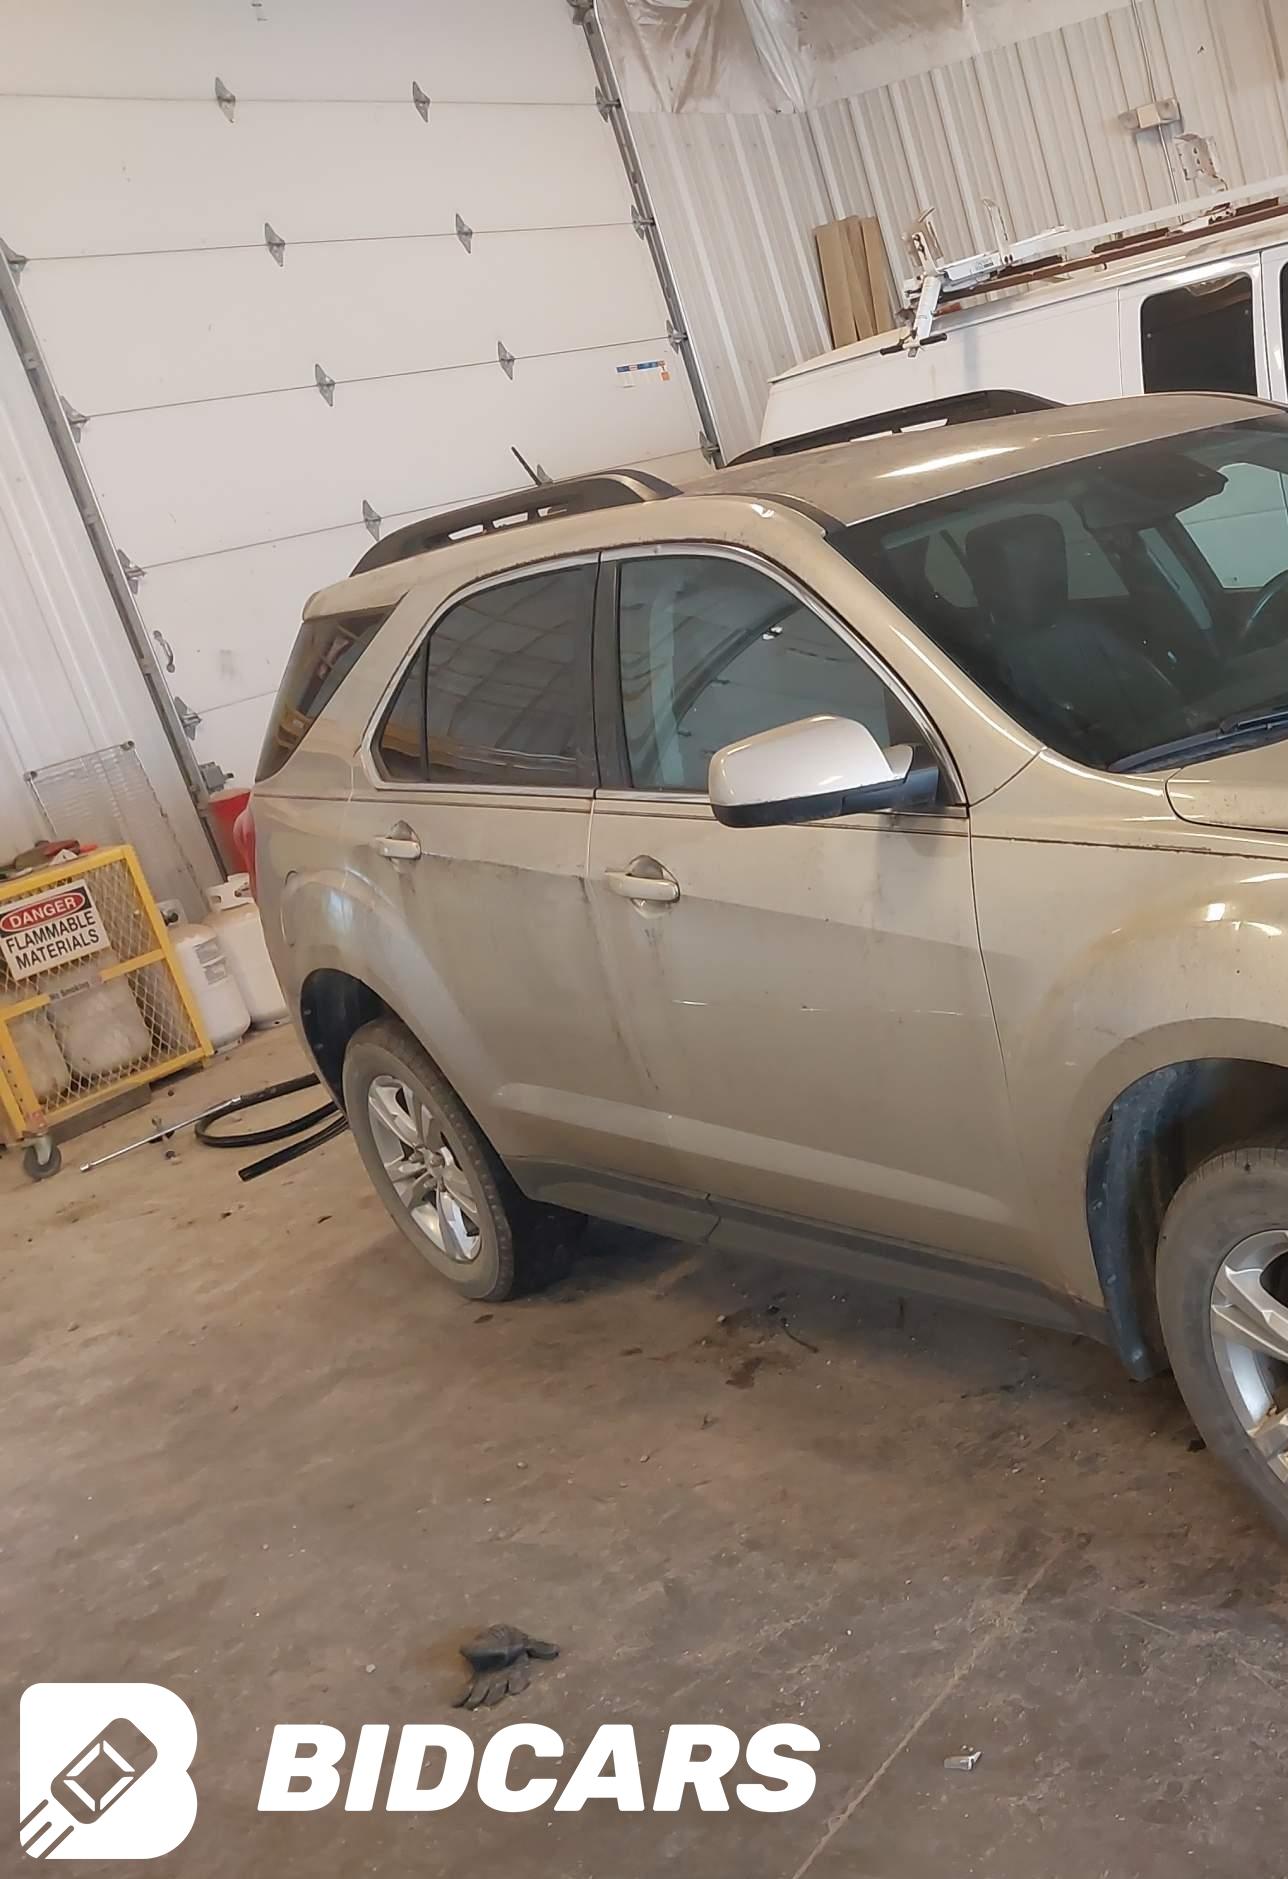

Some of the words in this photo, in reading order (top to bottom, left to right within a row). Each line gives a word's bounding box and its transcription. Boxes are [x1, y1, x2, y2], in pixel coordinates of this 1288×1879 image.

[6, 910, 96, 954] FLAMMABLE
[9, 896, 77, 928] DANGER
[15, 928, 100, 970] MATERIALS
